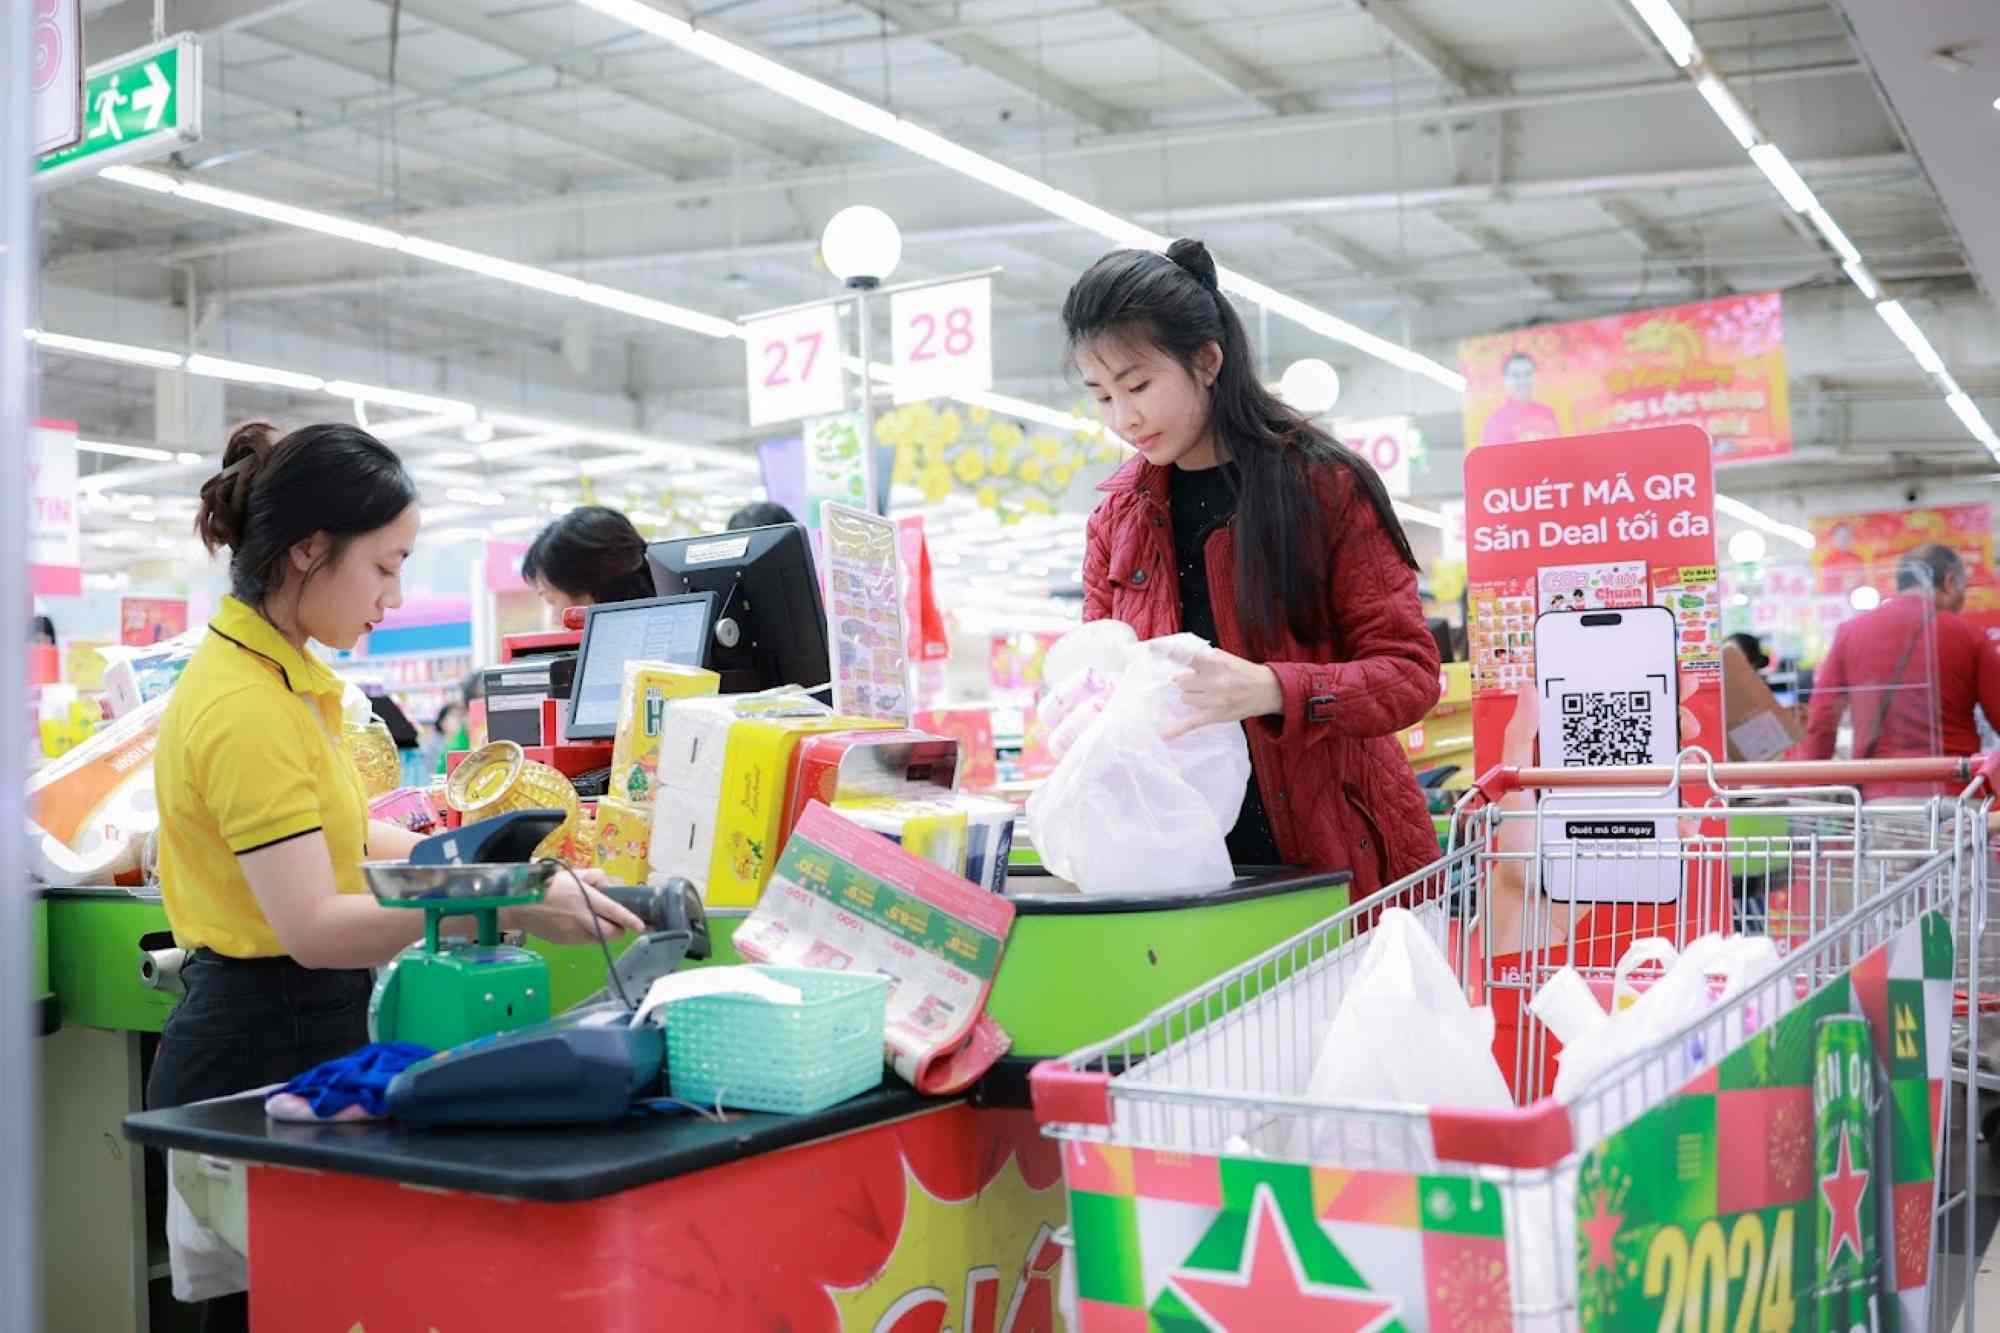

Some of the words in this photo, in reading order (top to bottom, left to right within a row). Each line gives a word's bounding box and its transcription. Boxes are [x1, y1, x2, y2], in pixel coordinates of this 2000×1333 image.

[908, 307, 975, 362] 28
[762, 331, 824, 388] 27
[1483, 478, 1574, 514] QUÉT
[1583, 472, 1635, 506] MÃ
[1643, 472, 1697, 501] QR
[1473, 524, 1530, 552] Săn
[1539, 517, 1607, 547] Deal
[1616, 511, 1658, 542] tối
[1668, 511, 1710, 538] đa
[1611, 826, 1627, 834] QR
[1628, 826, 1652, 836] ngay
[1644, 1207, 1795, 1333] 2024
